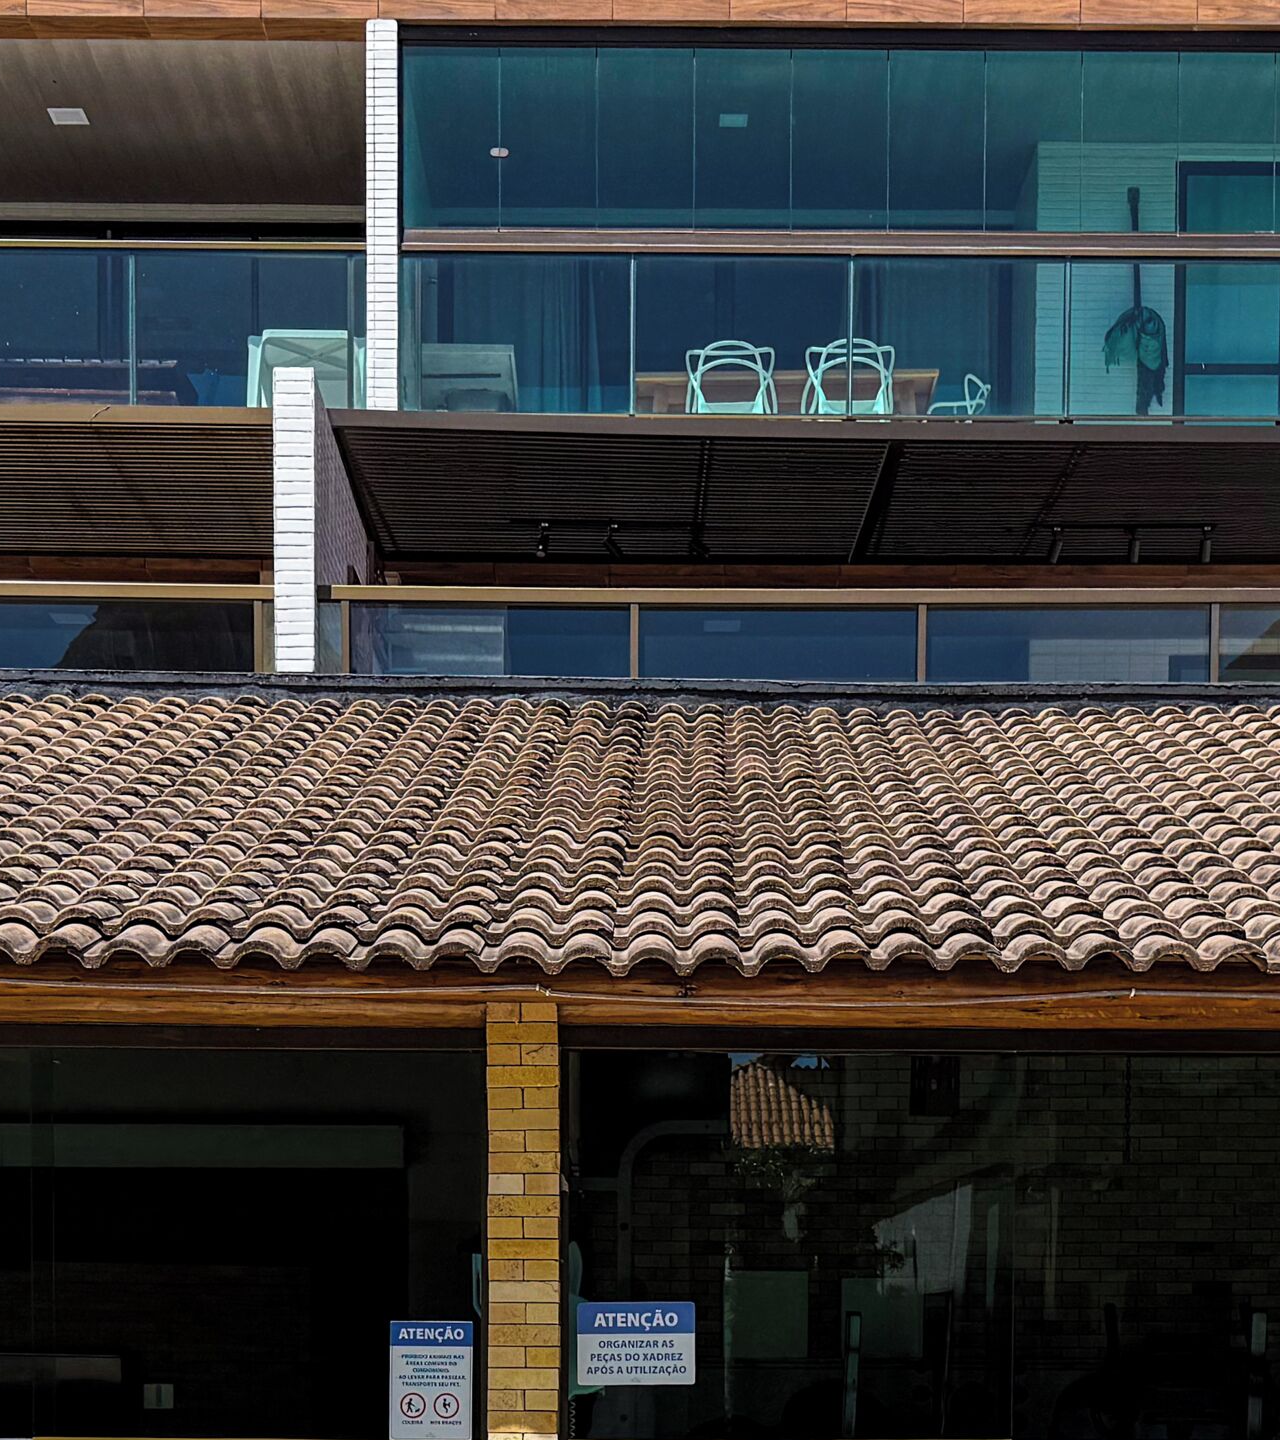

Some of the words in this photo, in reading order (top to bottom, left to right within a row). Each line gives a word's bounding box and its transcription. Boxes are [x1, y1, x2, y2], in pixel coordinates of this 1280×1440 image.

[594, 1309, 679, 1331] ATENÇÃO
[398, 1326, 464, 1343] ATENÇÃO
[598, 1340, 659, 1349] ORGANIZAR
[661, 1340, 674, 1348] AS
[590, 1353, 622, 1364] PEÇAS
[624, 1353, 640, 1361] DO
[642, 1353, 683, 1361] XADREZ
[586, 1365, 615, 1375] APÓS
[616, 1366, 624, 1374] A
[626, 1364, 687, 1376] UTILIZAÇÃO
